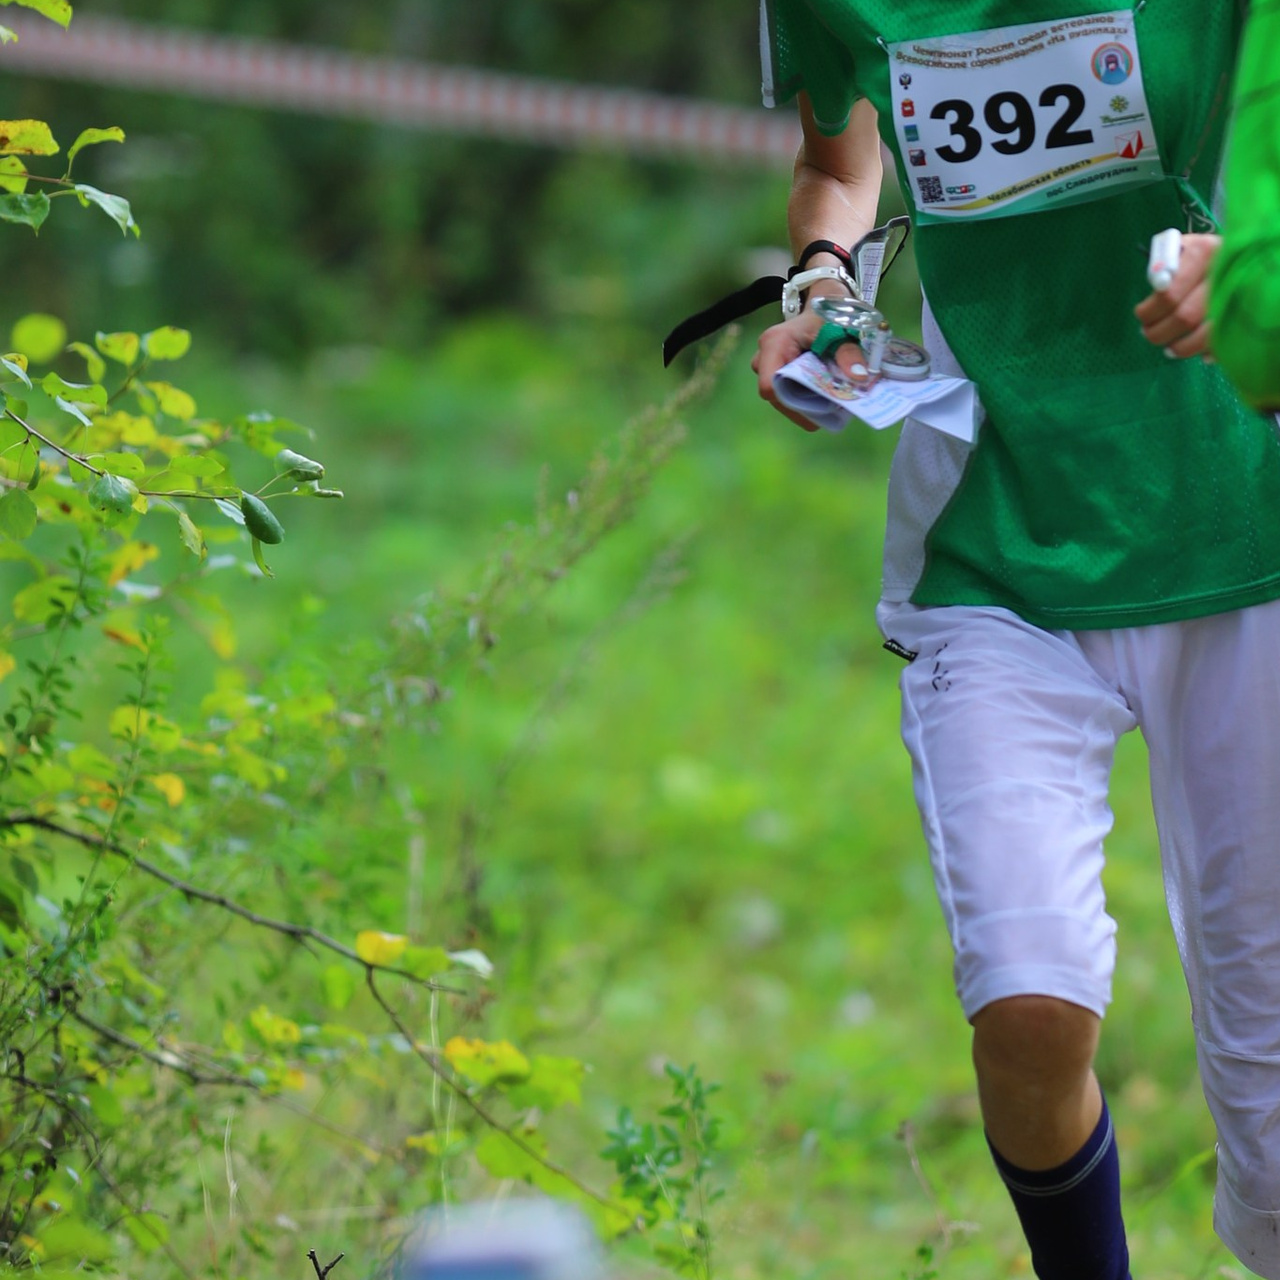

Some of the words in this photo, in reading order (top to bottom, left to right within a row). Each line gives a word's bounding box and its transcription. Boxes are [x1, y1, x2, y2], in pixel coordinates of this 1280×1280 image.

[977, 40, 1015, 60] России
[1018, 29, 1048, 45] среди
[1050, 15, 1115, 33] ветеранов
[930, 84, 1094, 163] 392
[988, 171, 1051, 202] Челябинская
[1053, 158, 1092, 177] область
